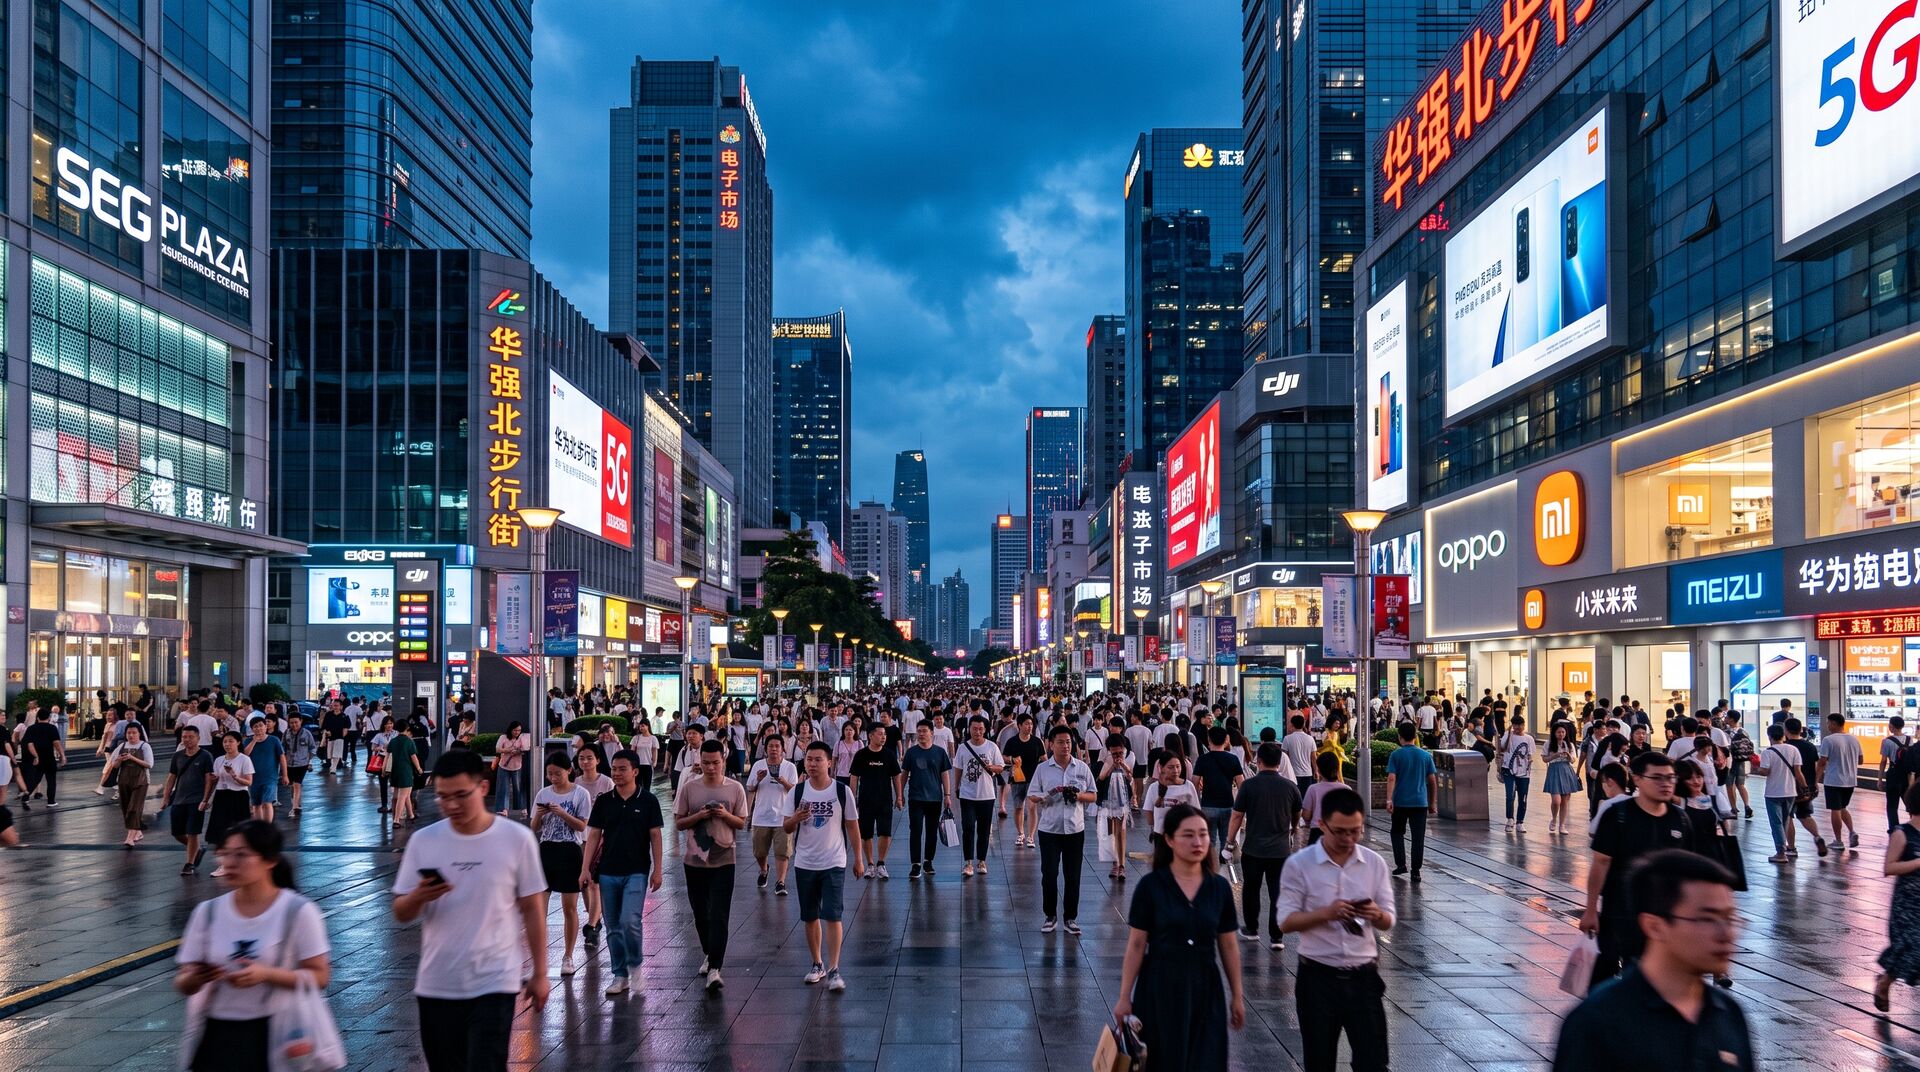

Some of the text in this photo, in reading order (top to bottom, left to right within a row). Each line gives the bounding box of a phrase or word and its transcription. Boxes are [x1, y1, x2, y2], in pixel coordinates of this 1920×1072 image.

[1814, 0, 1920, 147] 5G
[57, 147, 249, 284] SEG PLAZA
[720, 149, 739, 229] 电子市场
[488, 326, 522, 547] 华强北步行街
[606, 433, 628, 506] 5G
[1575, 584, 1638, 618] 小米米来
[1687, 572, 1762, 605] MEIZU
